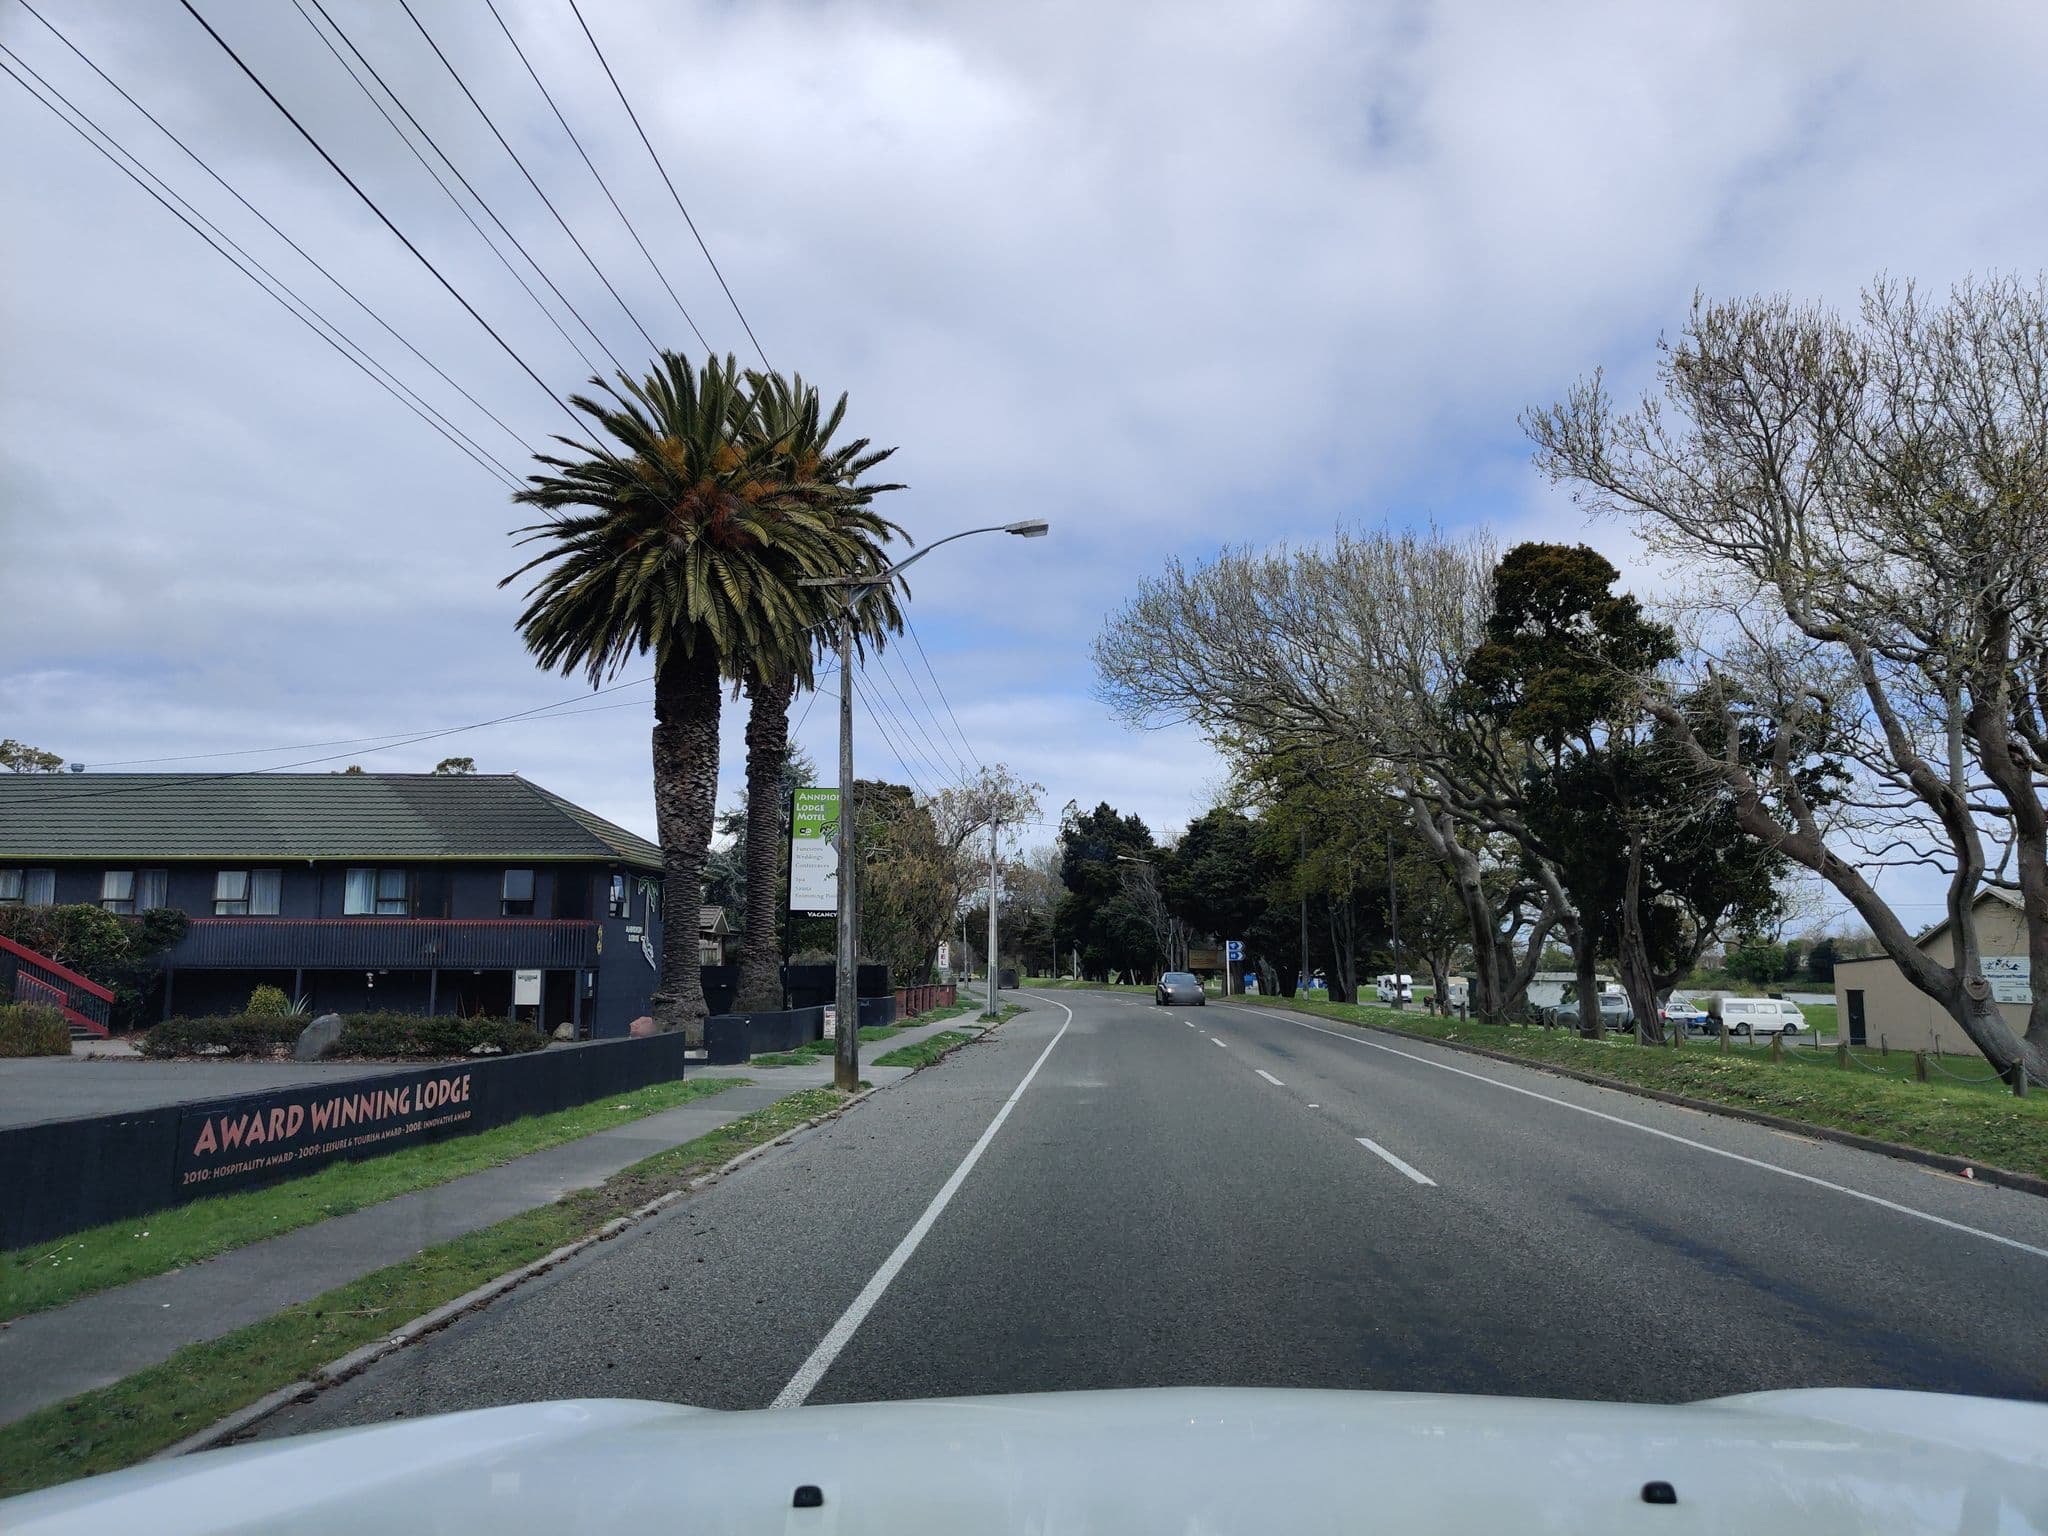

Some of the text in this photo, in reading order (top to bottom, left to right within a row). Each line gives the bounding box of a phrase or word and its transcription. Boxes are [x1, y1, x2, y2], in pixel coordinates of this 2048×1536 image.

[796, 803, 825, 811] LODGE
[183, 1170, 211, 1185] 2010:
[213, 1157, 265, 1178] HOSPITALITY
[266, 1150, 293, 1166] AWARD
[322, 1138, 348, 1153] LEISURE
[354, 1131, 380, 1147] TOURISM
[380, 1126, 402, 1140] AWARD
[453, 1110, 472, 1122] AWARD
[193, 1074, 471, 1157] AWARD WINNING LODGE
